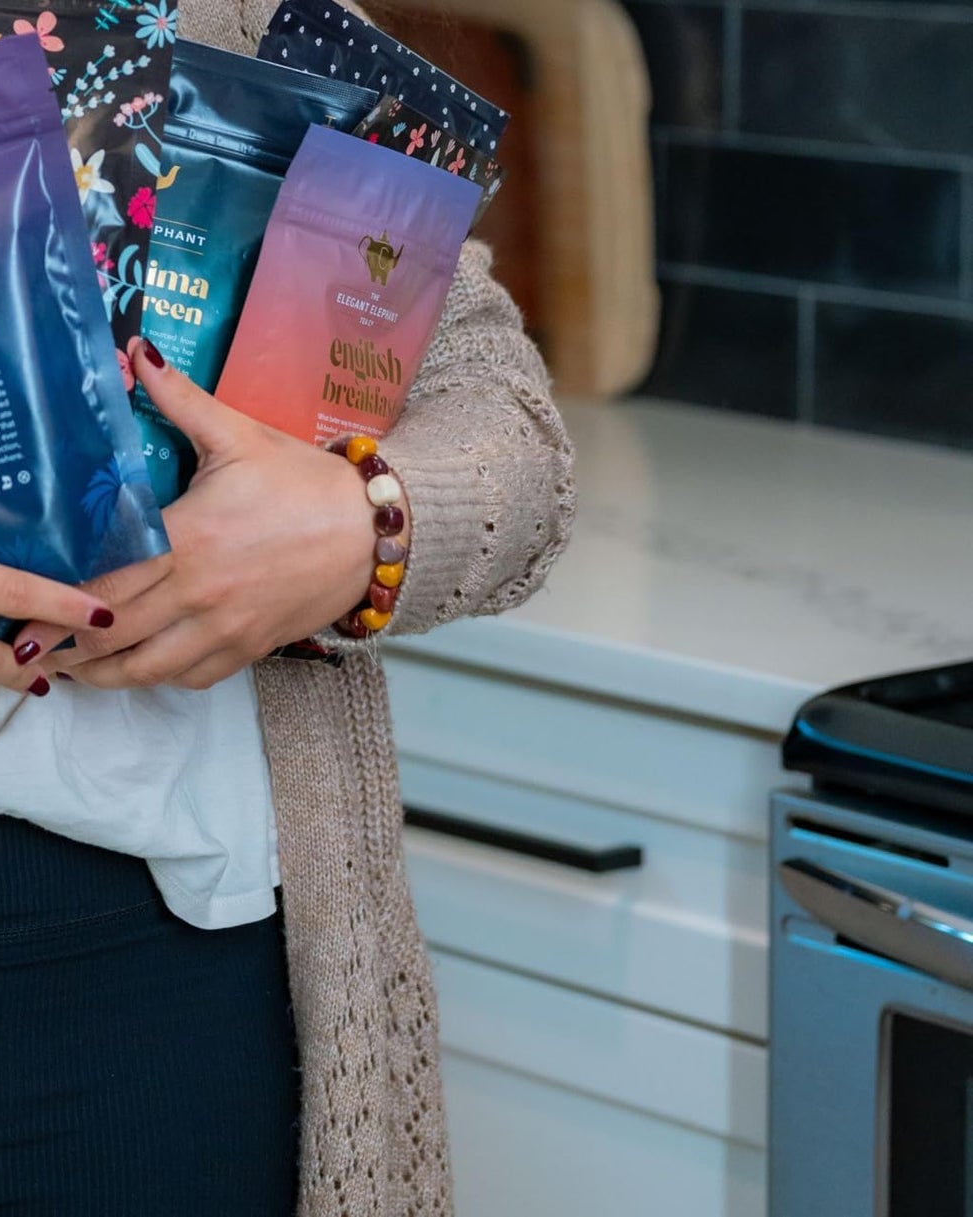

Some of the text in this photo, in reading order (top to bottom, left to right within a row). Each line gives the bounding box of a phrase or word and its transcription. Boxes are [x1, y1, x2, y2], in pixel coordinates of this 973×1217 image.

[154, 225, 206, 246] PHANT
[147, 260, 209, 299] ima
[337, 293, 398, 322] ELEGANT ELEPHANT
[371, 292, 380, 301] THE
[142, 296, 202, 325] reen
[330, 338, 401, 385] english
[1, 420, 14, 429] that
[3, 432, 17, 440] ever
